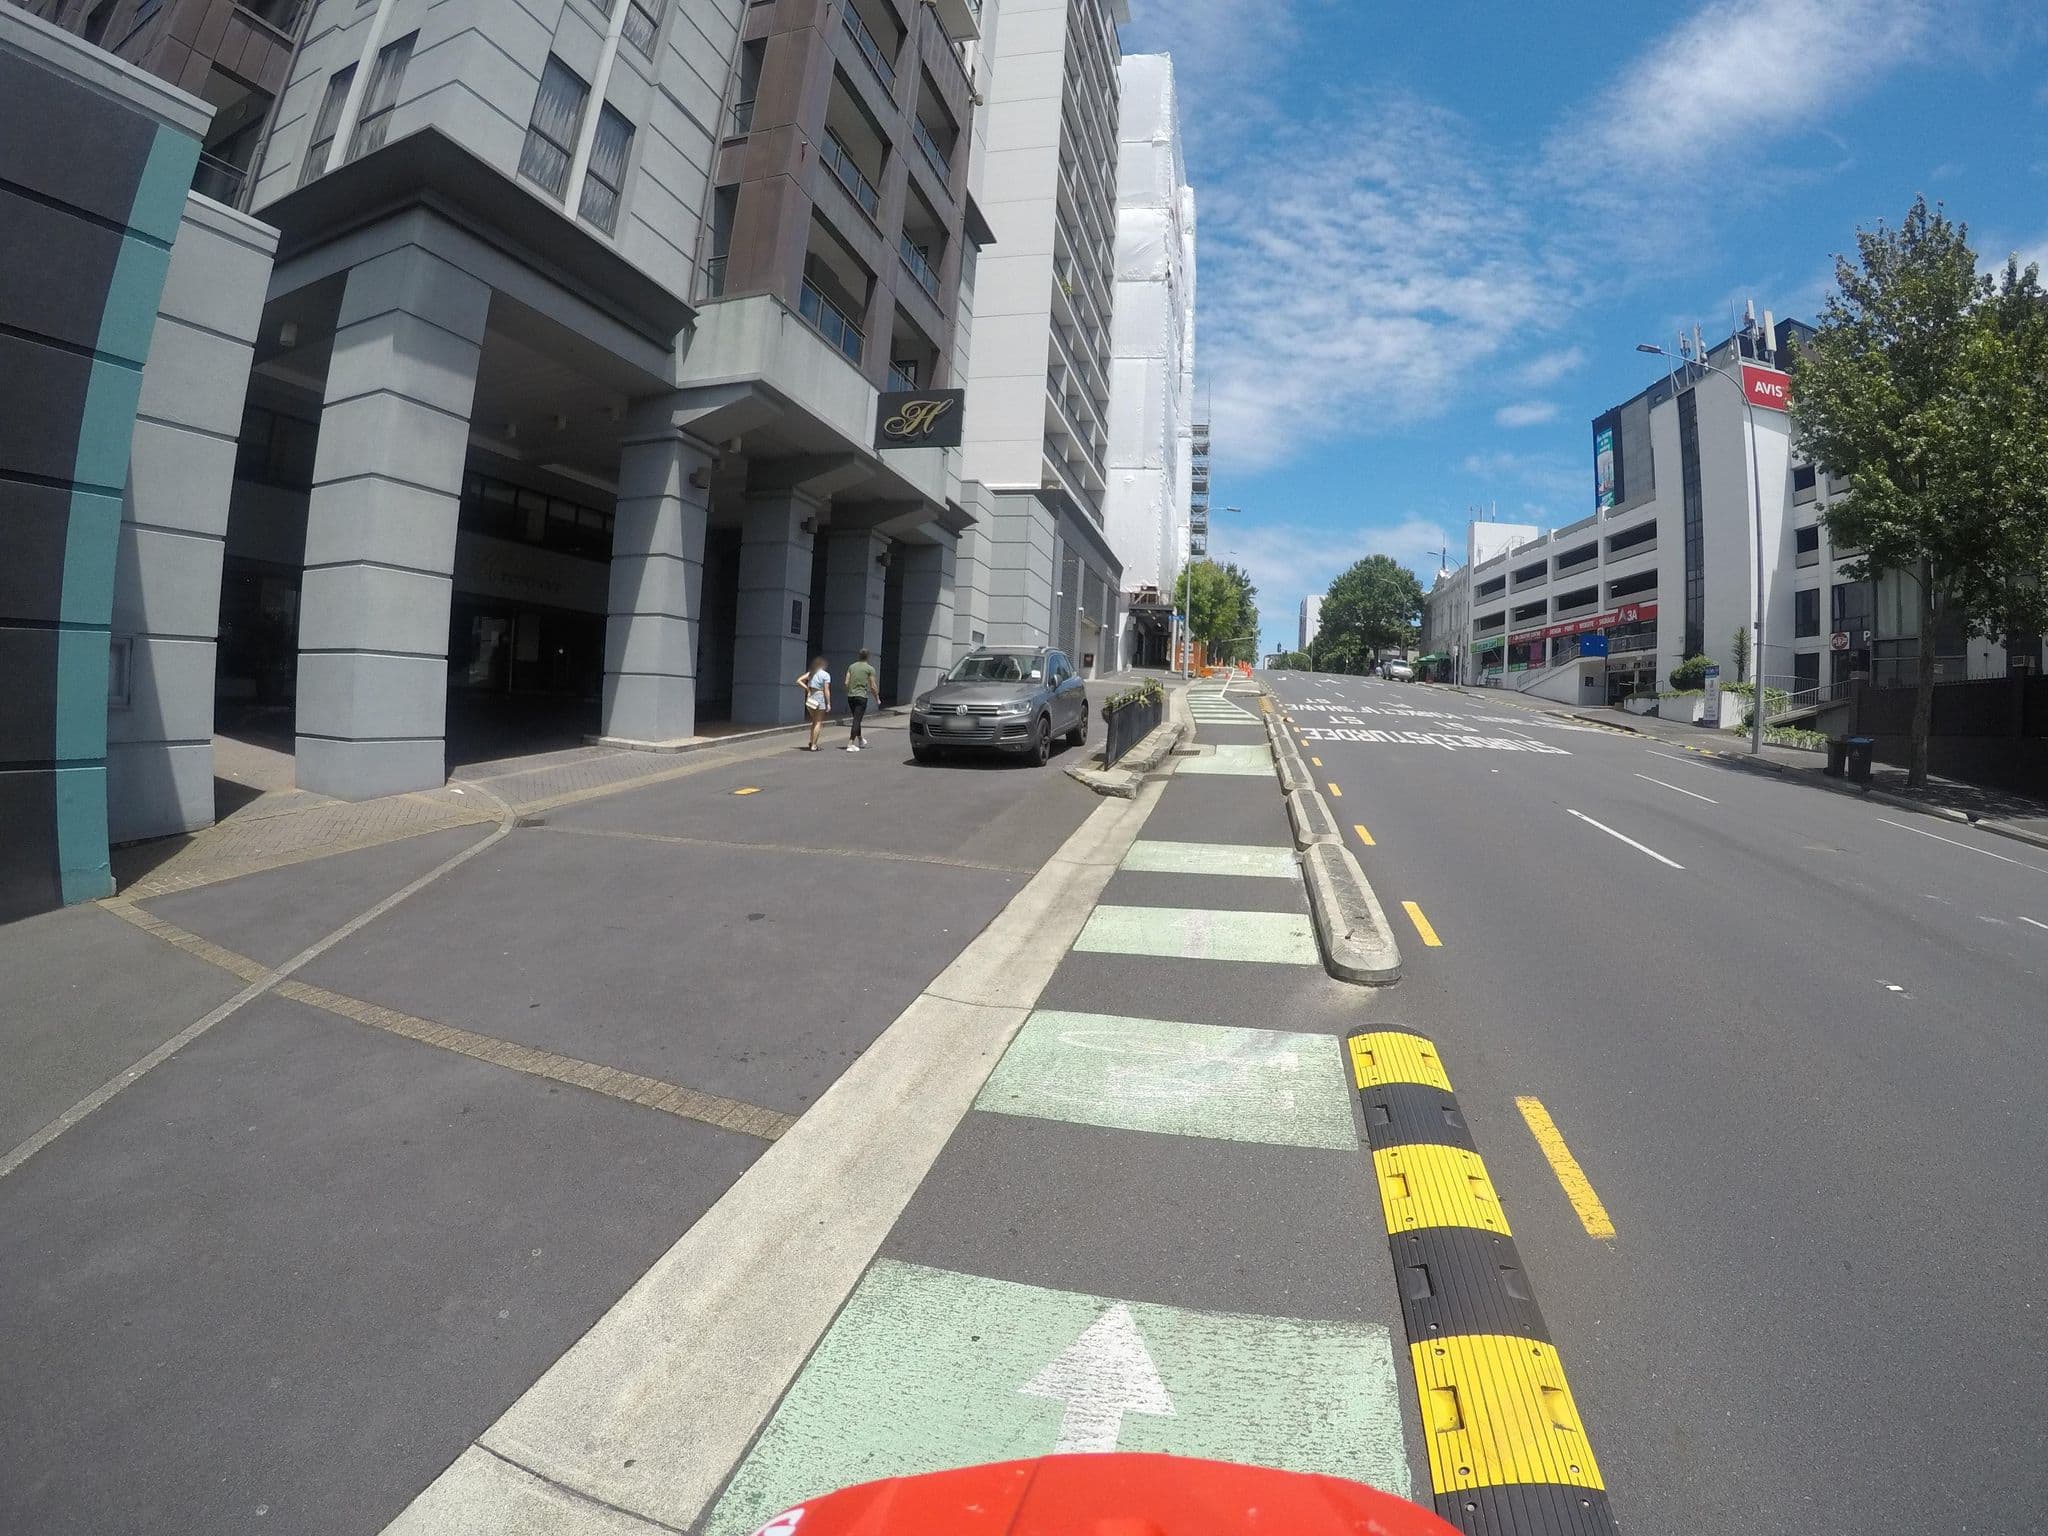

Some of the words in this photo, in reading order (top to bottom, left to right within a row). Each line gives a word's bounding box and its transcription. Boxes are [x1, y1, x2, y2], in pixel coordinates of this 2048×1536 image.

[1755, 381, 1783, 398] AVIS
[1627, 609, 1638, 621] 3A
[1328, 715, 1365, 725] ST
[1300, 727, 1435, 745] STURDEE
